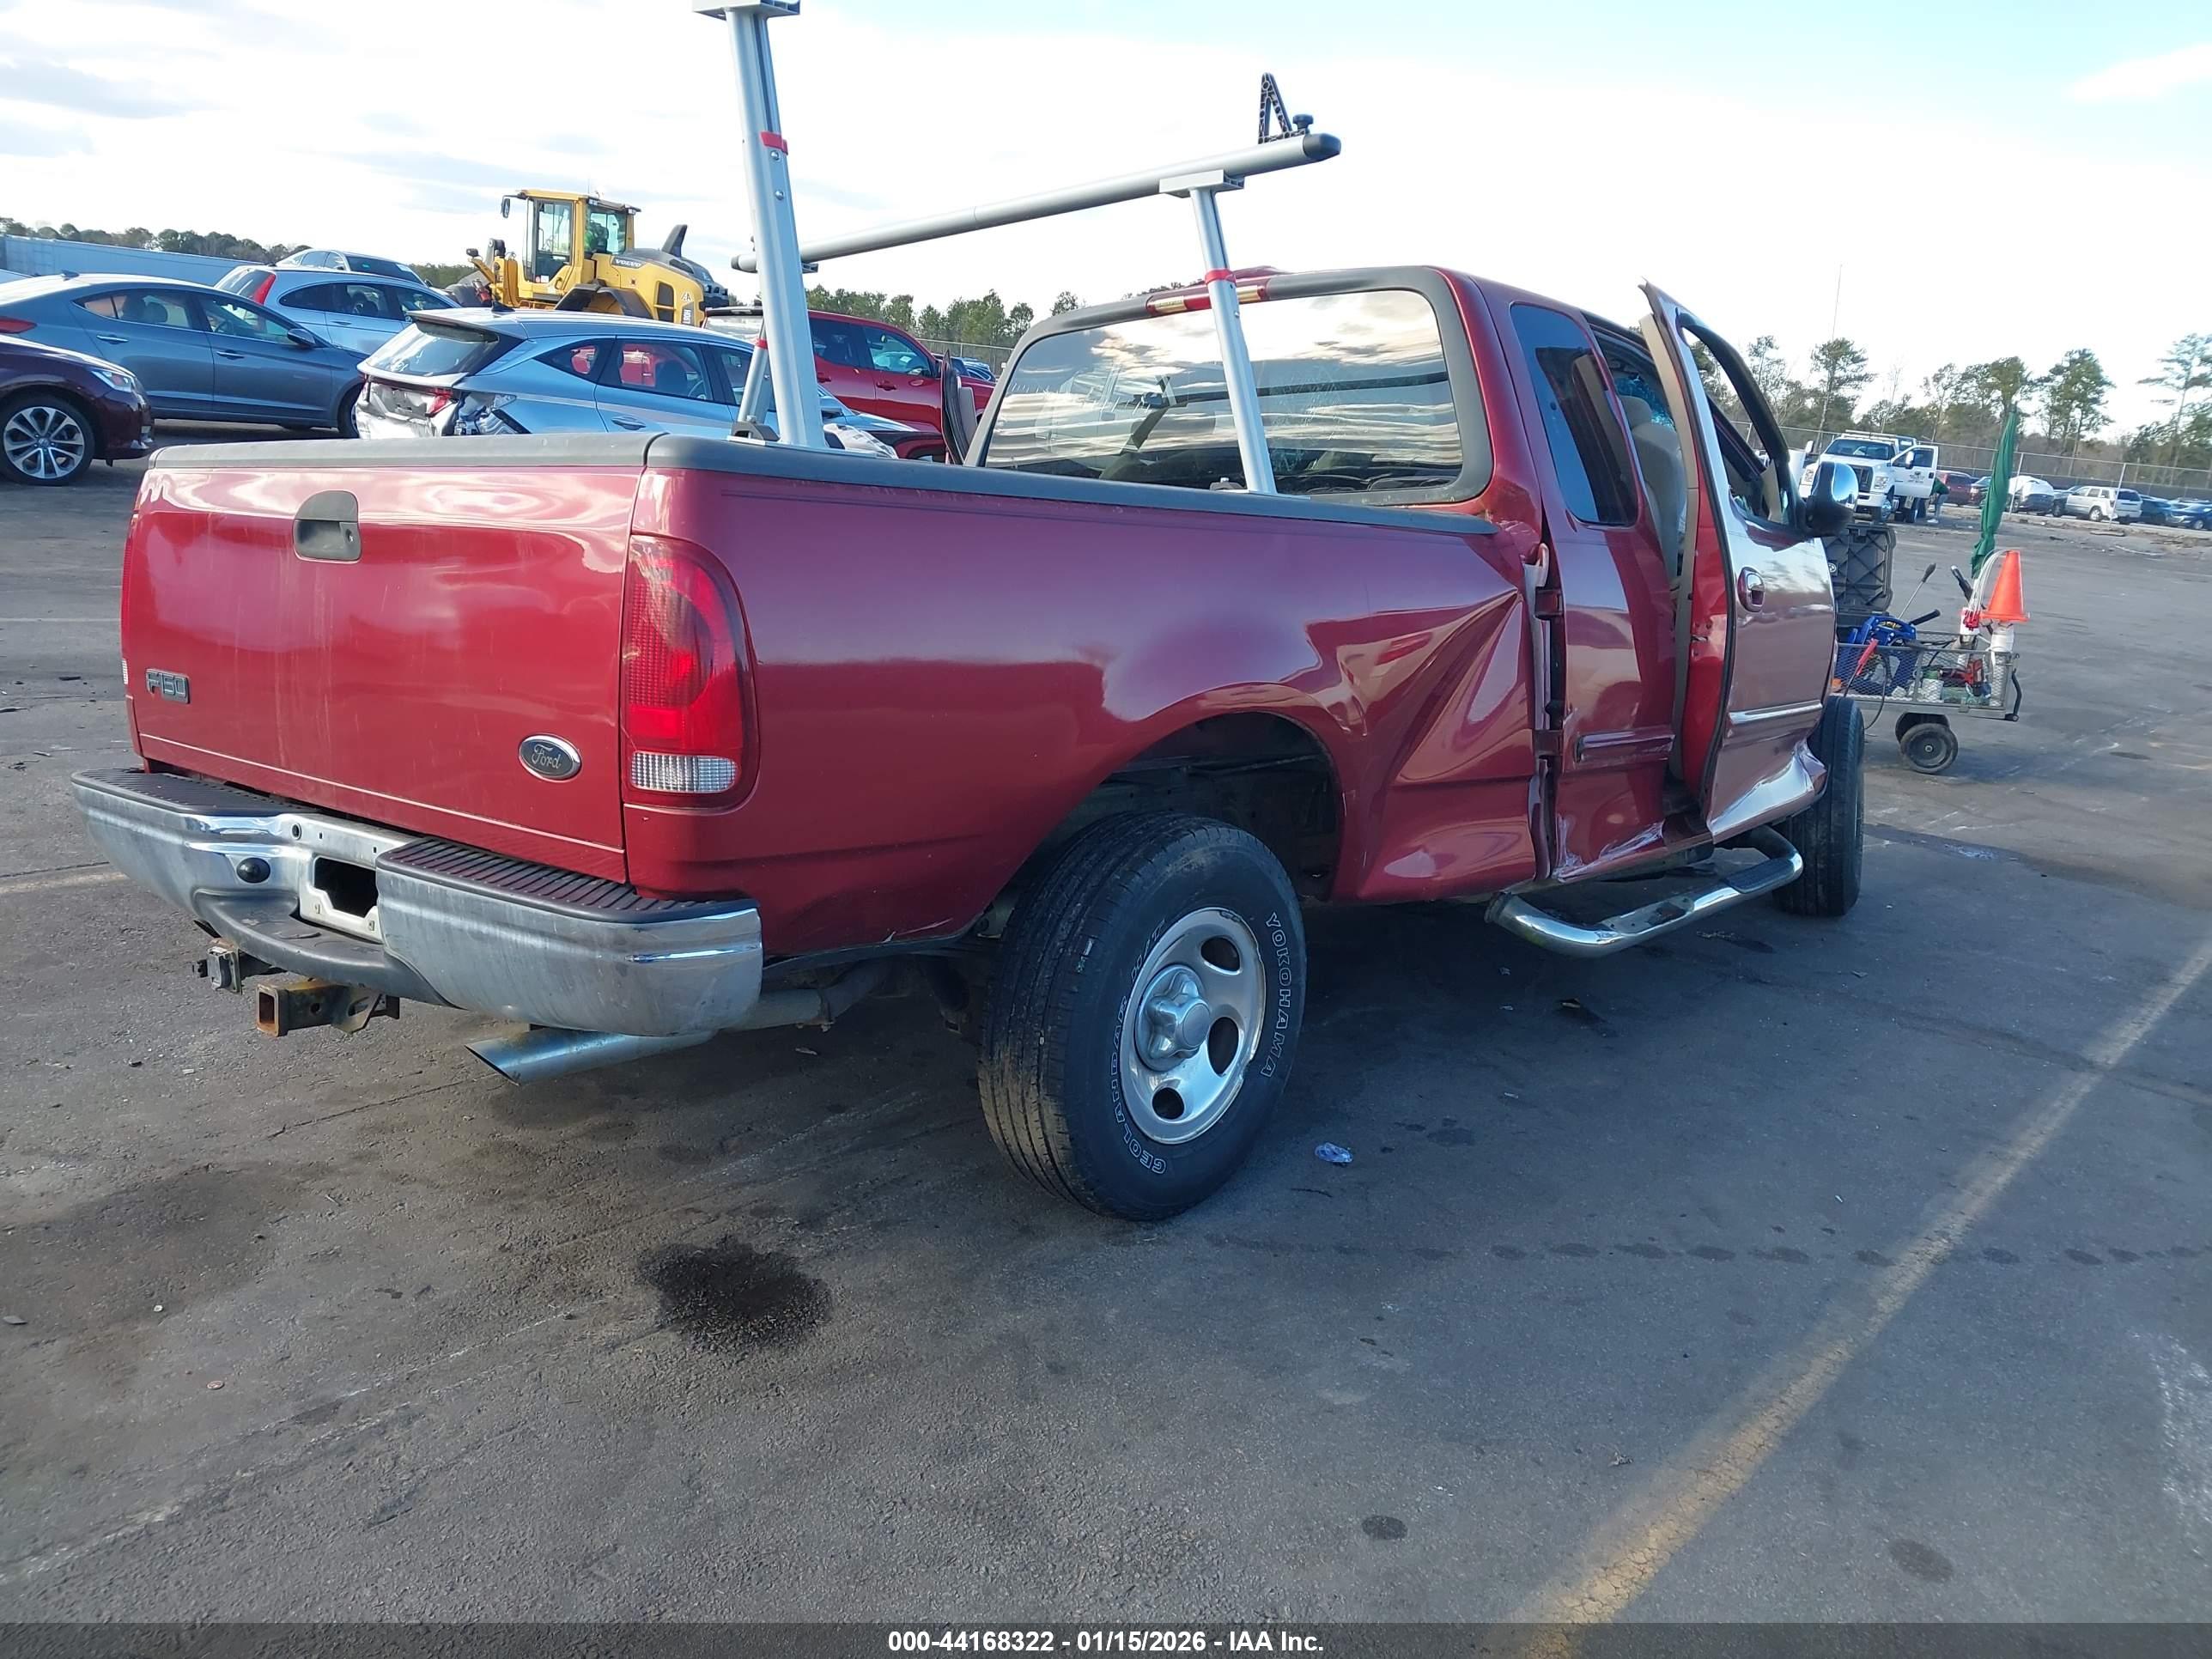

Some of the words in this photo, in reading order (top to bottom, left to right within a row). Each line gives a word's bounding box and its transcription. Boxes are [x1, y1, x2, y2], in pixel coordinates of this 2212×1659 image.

[615, 258, 641, 267] VOLVO
[531, 744, 562, 769] Ford
[1260, 911, 1292, 1078] YOKOHAMA
[1110, 995, 1167, 1175] GEOLANDAR
